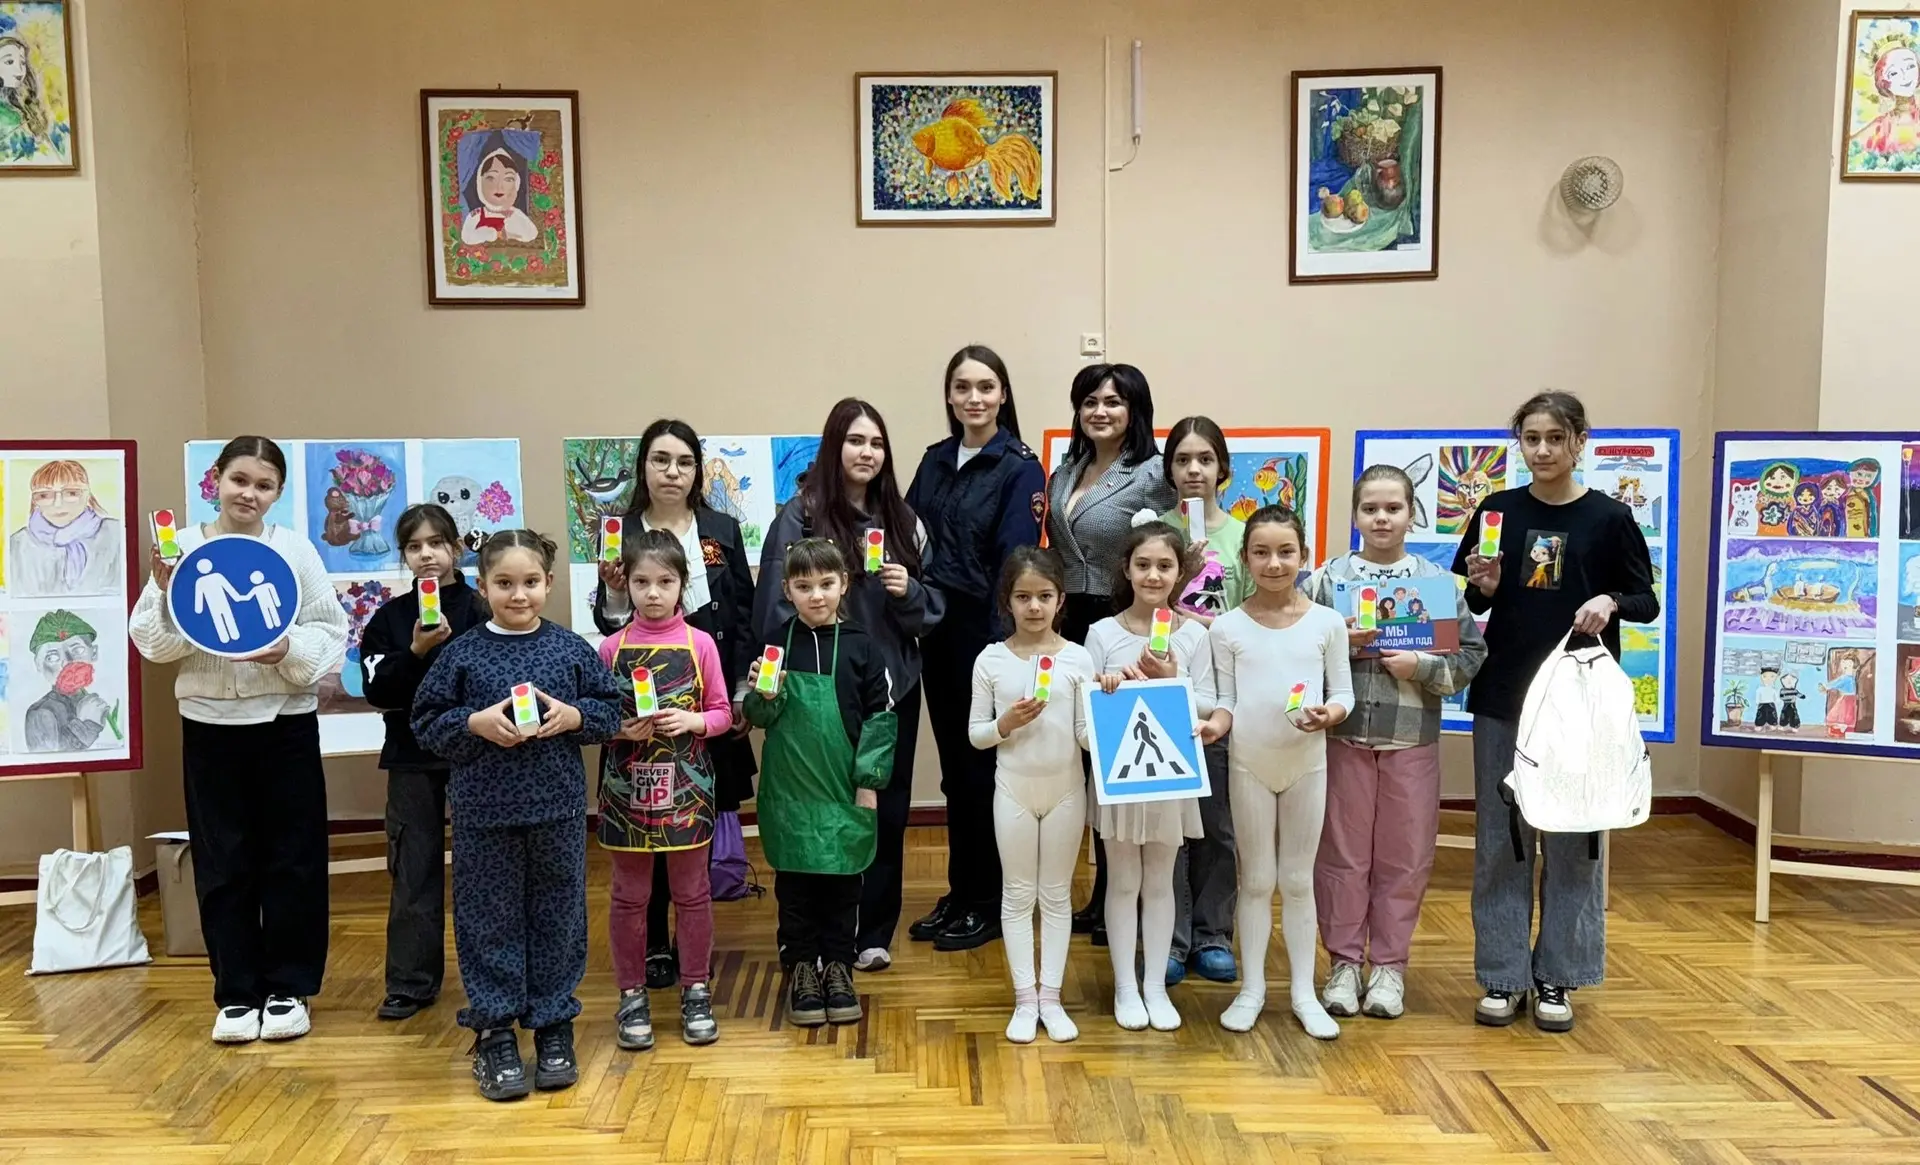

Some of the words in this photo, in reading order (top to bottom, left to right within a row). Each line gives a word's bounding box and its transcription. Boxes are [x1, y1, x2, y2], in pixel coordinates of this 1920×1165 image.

[1385, 625, 1407, 637] МЫ
[1415, 636, 1433, 646] ПДД
[636, 768, 670, 776] NEVER
[637, 776, 669, 787] GIVE
[636, 788, 668, 805] UP
